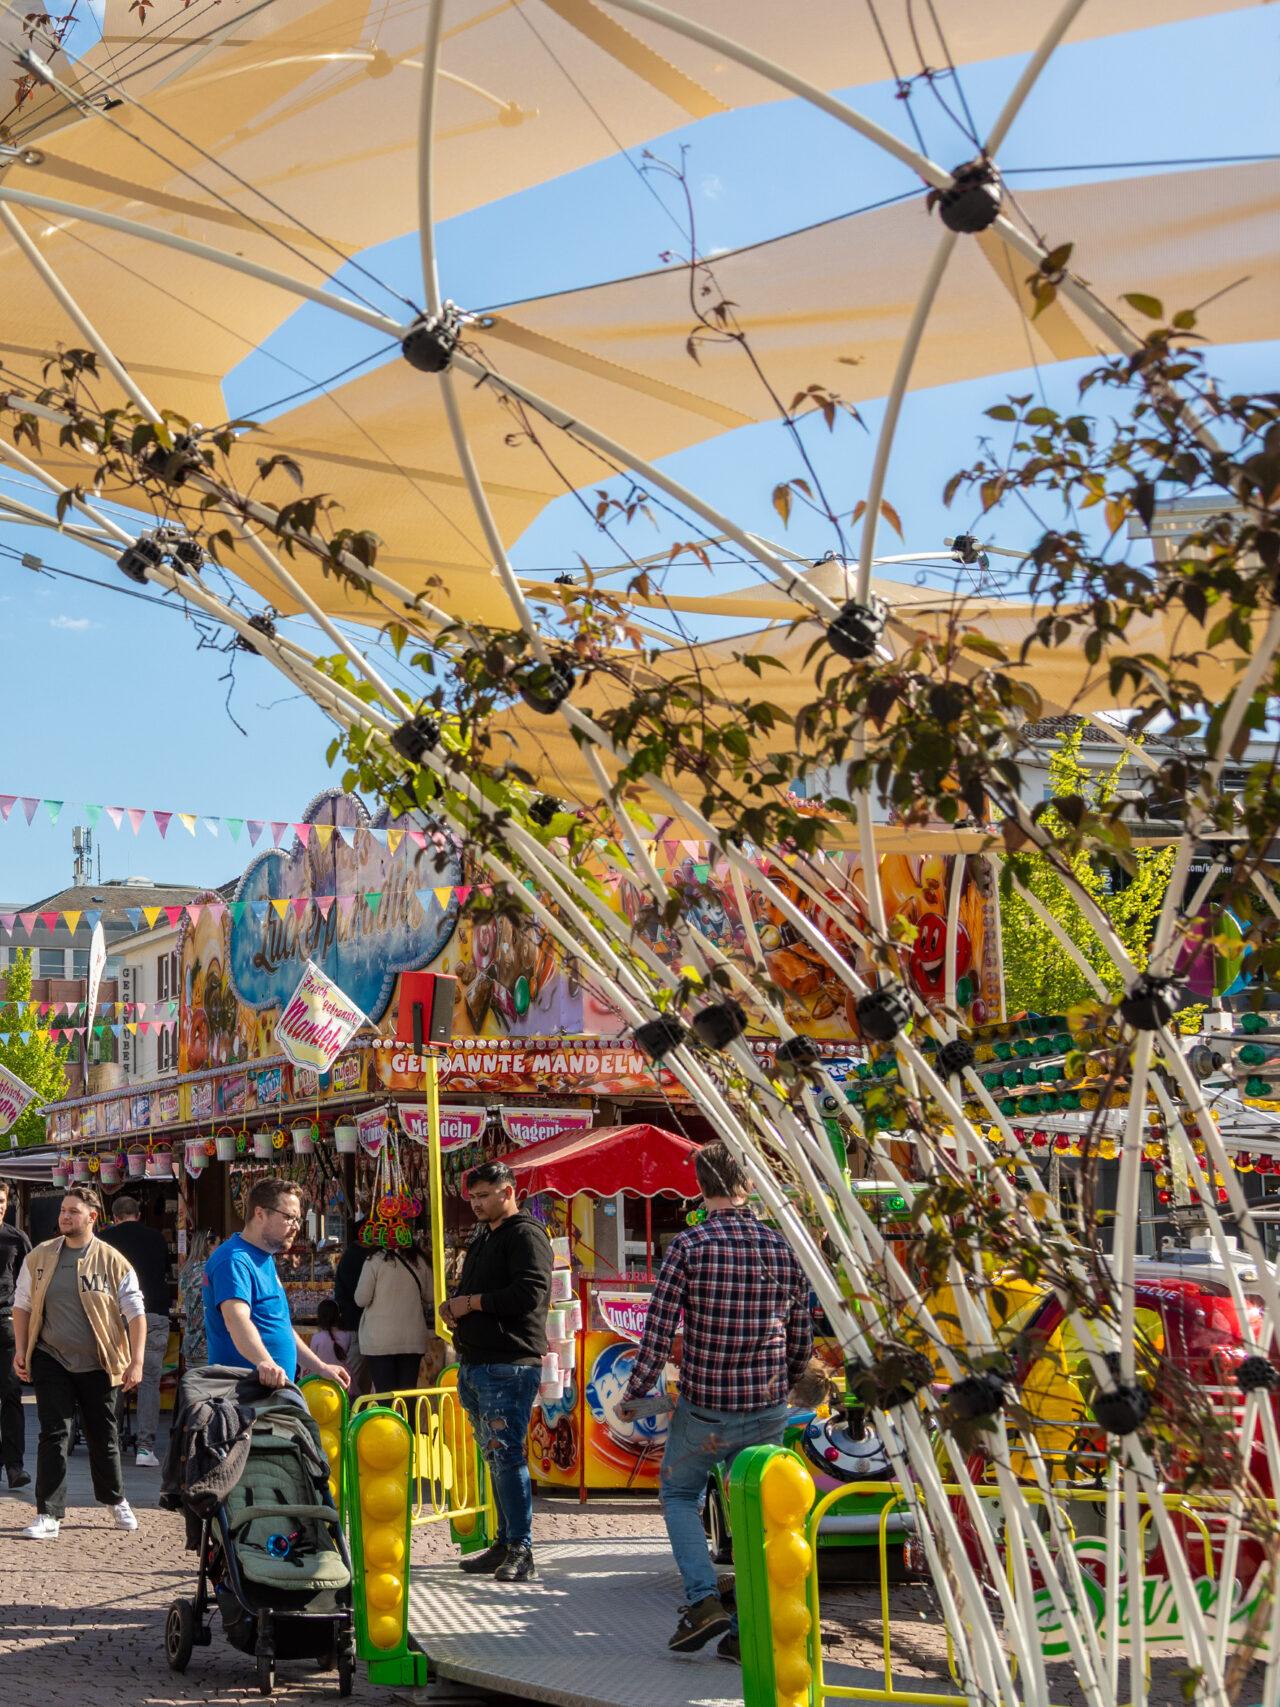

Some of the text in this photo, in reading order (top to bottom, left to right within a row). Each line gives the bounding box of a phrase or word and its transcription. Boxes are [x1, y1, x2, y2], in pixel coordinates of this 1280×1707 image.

[281, 996, 342, 1060] Mandeln
[532, 1053, 645, 1074] MANDELN
[410, 1118, 472, 1138] Madeln
[510, 1122, 584, 1143] Magenb
[1136, 1285, 1181, 1300] SCUE
[608, 1306, 648, 1332] Zucker
